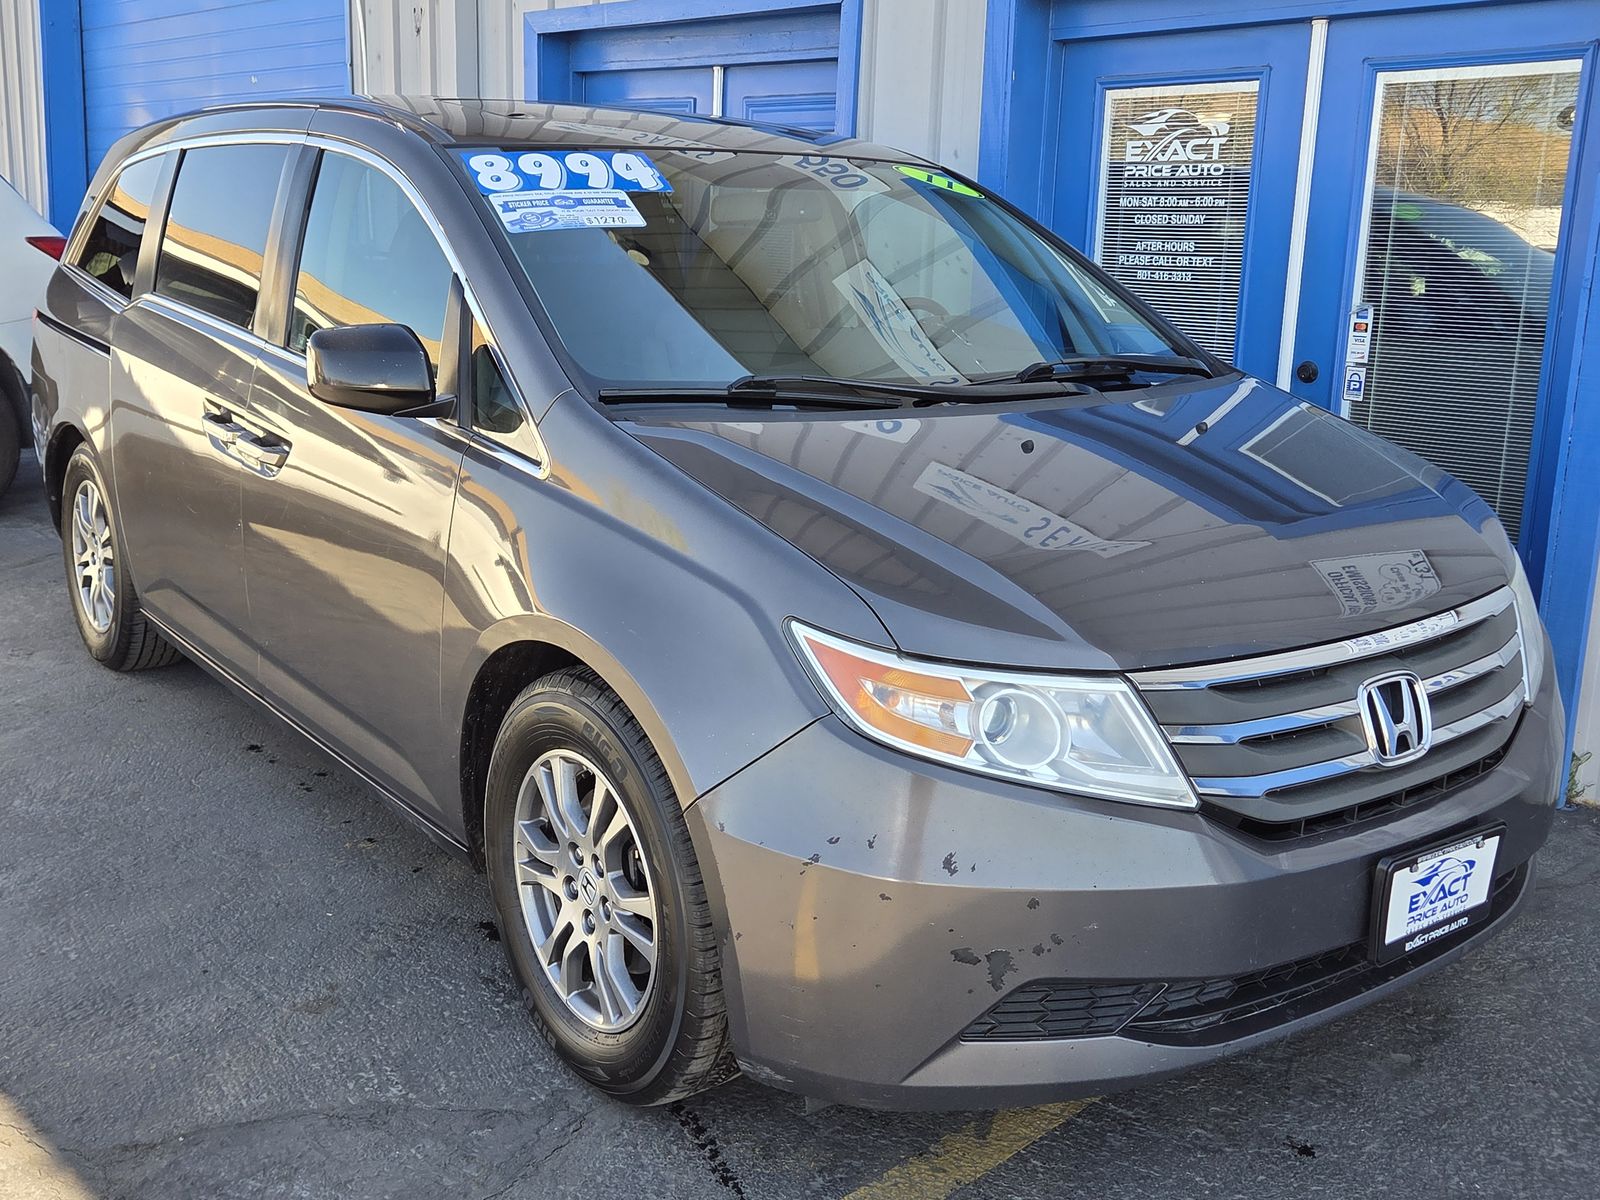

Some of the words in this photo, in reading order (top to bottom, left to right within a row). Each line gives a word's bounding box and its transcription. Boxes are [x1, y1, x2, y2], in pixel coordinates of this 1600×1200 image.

[1126, 137, 1228, 162] EXACT
[469, 152, 663, 190] 8994
[1124, 165, 1171, 177] PRICE
[1175, 164, 1224, 177] AUTO
[1182, 179, 1223, 187] SERVICE
[508, 200, 532, 209] STICKER
[532, 199, 550, 207] PRICE
[1134, 214, 1169, 224] CLOSED
[1171, 214, 1206, 224] SUNDAY
[1135, 242, 1162, 251] AFTER
[1164, 242, 1195, 252] HOURS
[1119, 255, 1150, 265] PLEASE
[1152, 256, 1173, 265] CALL
[1177, 257, 1190, 266] OR
[1192, 257, 1214, 266] TEXT
[582, 721, 613, 757] BIG
[1408, 872, 1472, 914] EXACT
[1406, 906, 1438, 927] PRICE
[1440, 893, 1468, 912] AUTO
[1405, 934, 1429, 952] EXACT
[1428, 924, 1451, 941] PRICE
[1449, 917, 1468, 930] AUTO
